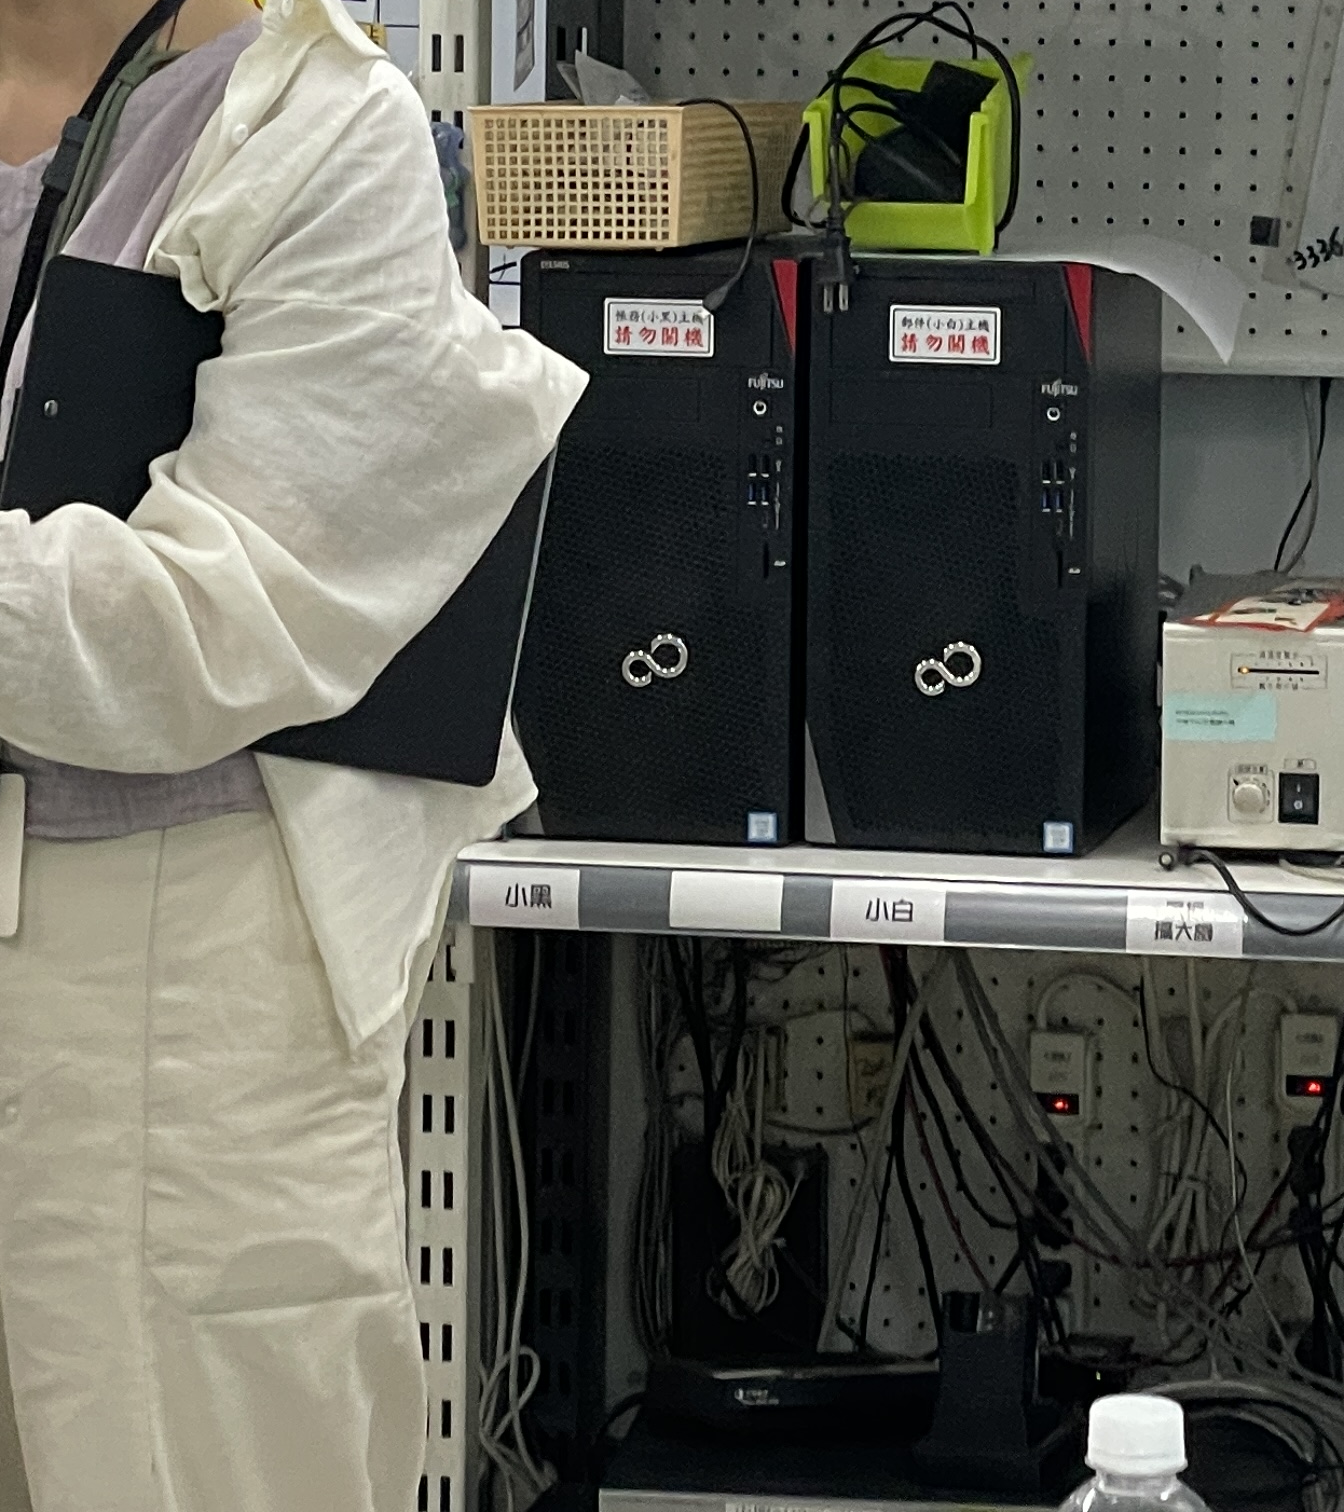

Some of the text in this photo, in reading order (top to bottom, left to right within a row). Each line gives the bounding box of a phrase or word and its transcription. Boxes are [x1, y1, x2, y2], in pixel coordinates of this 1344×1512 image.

[748, 372, 785, 391] FUJITSU
[1041, 377, 1078, 398] FUJITSU
[504, 883, 553, 909] 小黑
[865, 897, 915, 923] 小白
